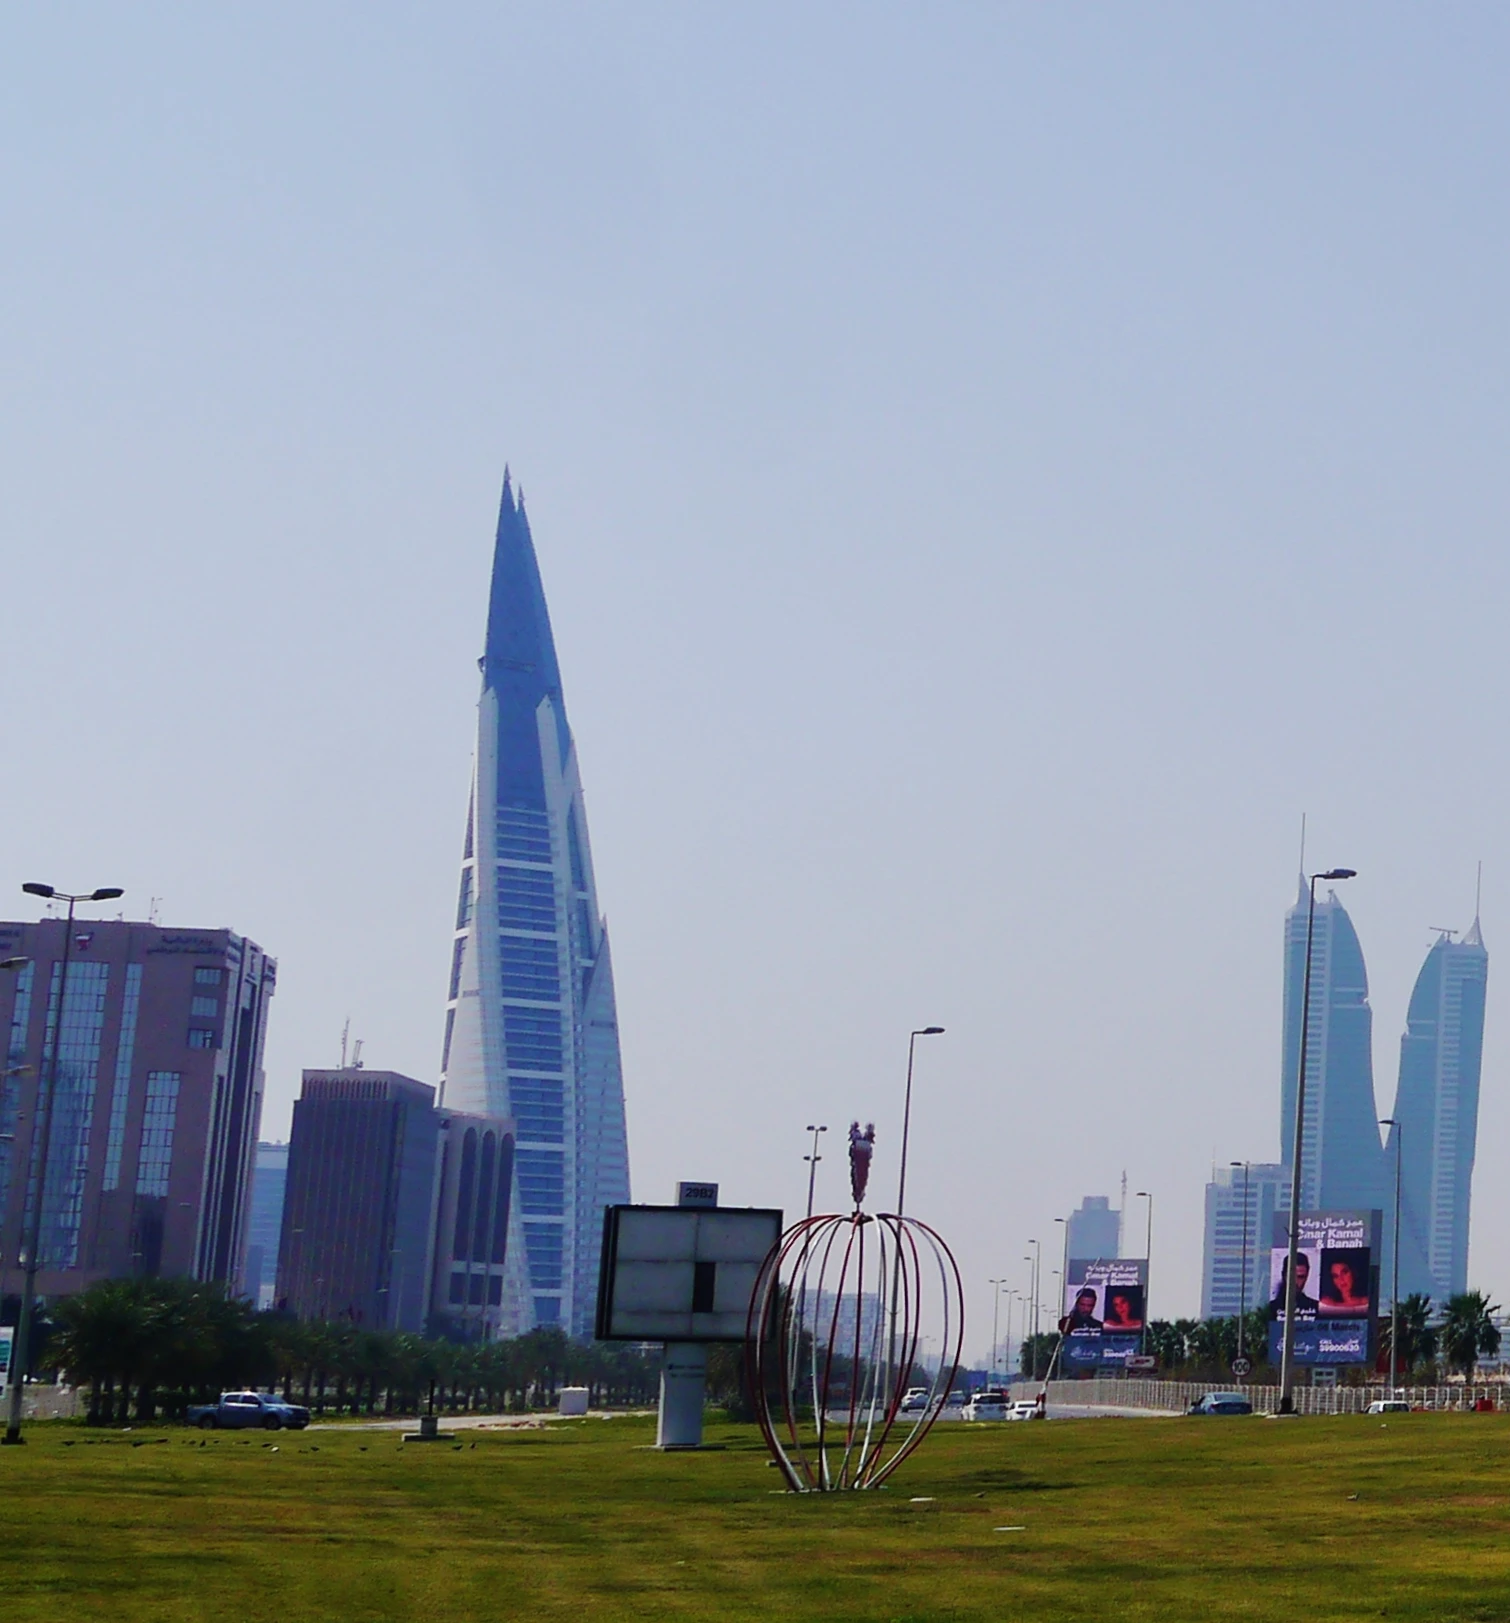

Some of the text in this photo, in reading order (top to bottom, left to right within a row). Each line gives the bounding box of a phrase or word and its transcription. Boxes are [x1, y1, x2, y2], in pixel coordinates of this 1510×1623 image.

[1327, 1228, 1364, 1239] Kamal
[1326, 1239, 1363, 1249] Banah
[1234, 1361, 1249, 1373] 100
